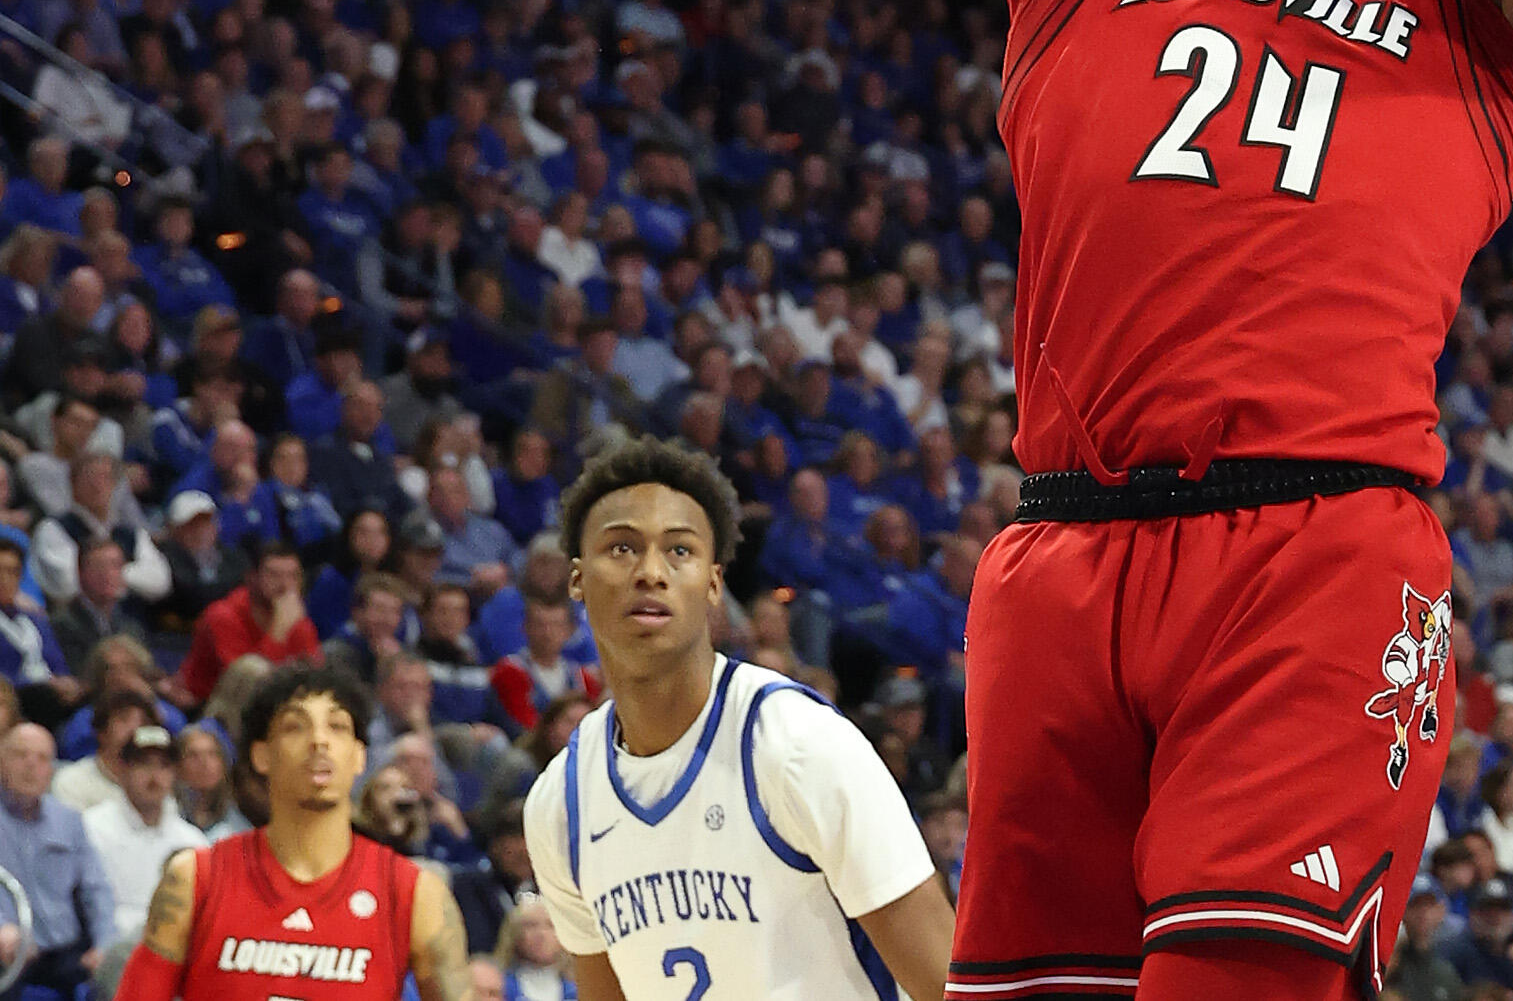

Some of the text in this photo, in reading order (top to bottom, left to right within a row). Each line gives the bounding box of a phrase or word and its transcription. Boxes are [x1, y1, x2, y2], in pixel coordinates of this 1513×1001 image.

[1130, 24, 1346, 200] 24
[593, 868, 759, 946] KENTUCKY
[218, 936, 372, 983] LOUISVILLE
